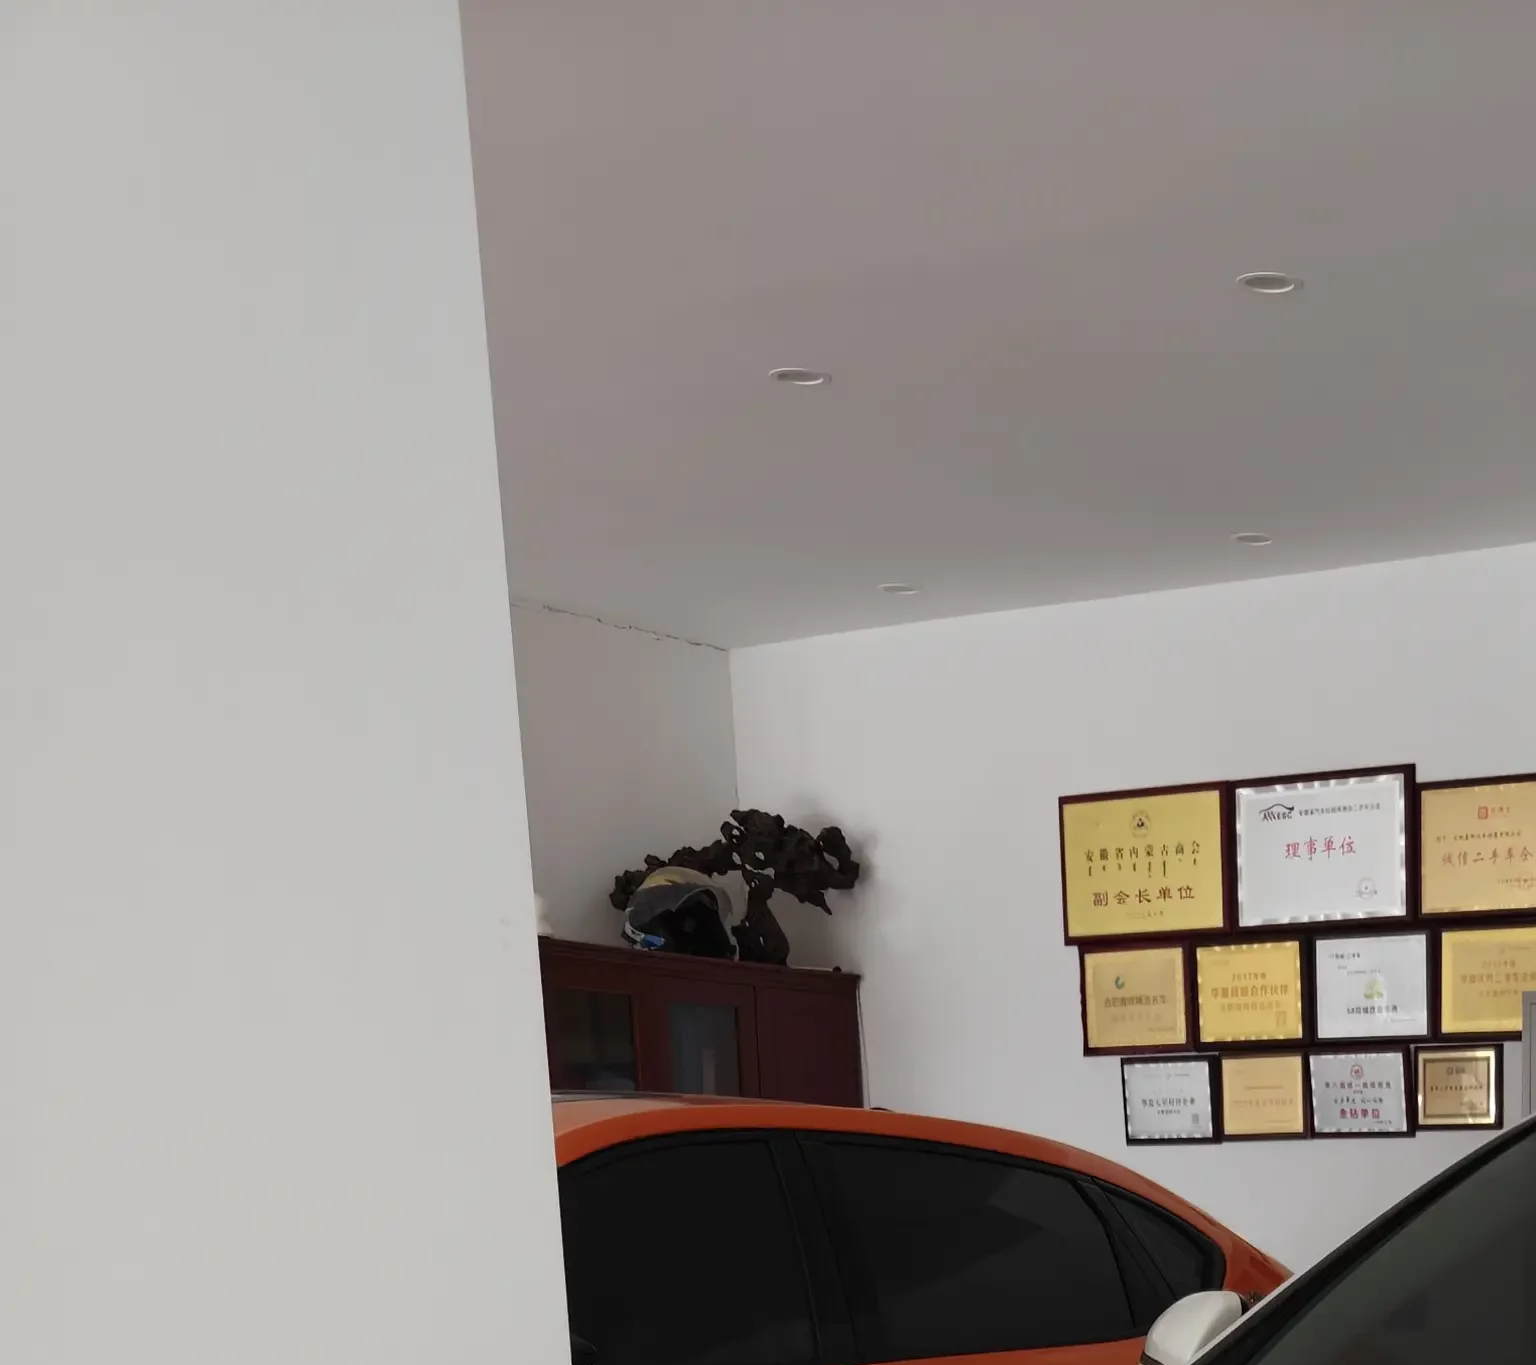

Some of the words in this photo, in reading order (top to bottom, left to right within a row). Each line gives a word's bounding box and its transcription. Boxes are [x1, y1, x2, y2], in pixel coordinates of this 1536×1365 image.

[1084, 840, 1200, 863] 安徽省内蒙古商会
[1285, 836, 1357, 861] 理事单位
[1092, 885, 1195, 908] 副会长单位
